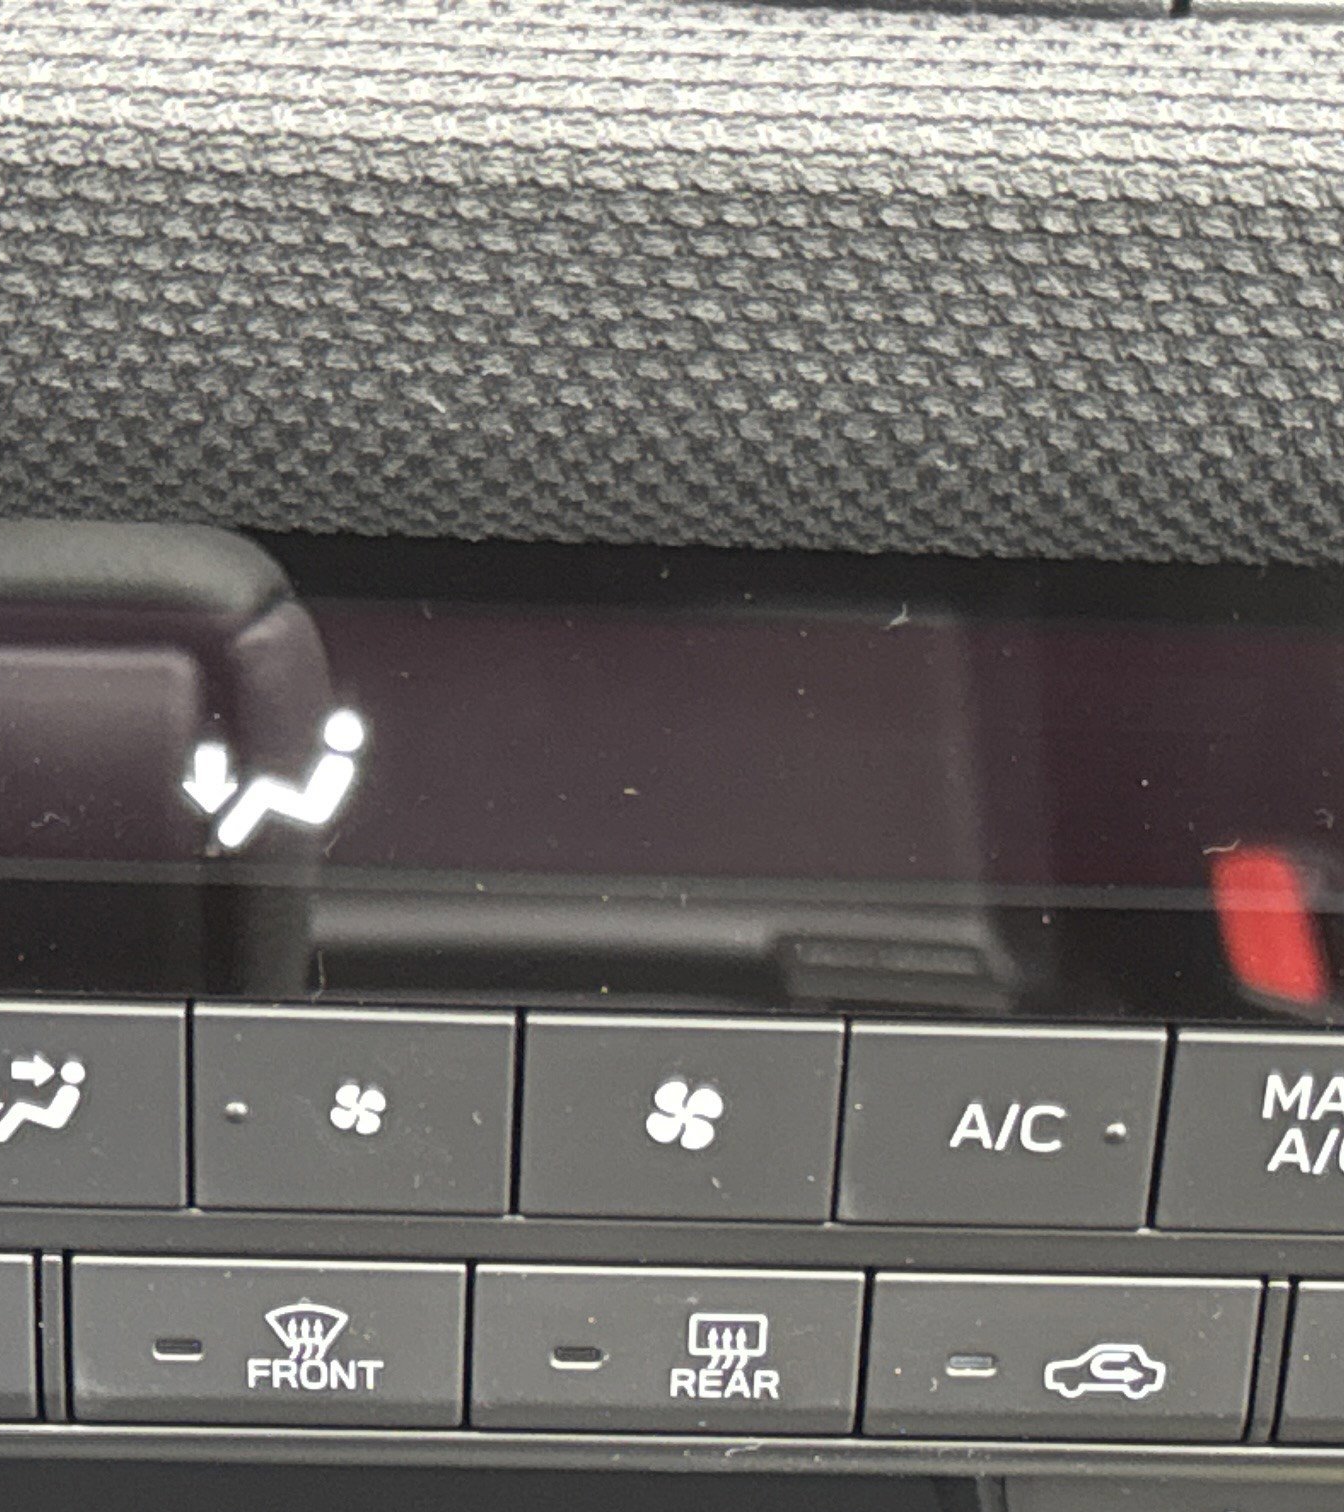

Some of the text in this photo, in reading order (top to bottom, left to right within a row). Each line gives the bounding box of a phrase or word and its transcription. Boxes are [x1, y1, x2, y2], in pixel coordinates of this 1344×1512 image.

[949, 1103, 1067, 1153] A/C
[247, 1359, 385, 1390] FRONT
[669, 1369, 780, 1399] REAR
